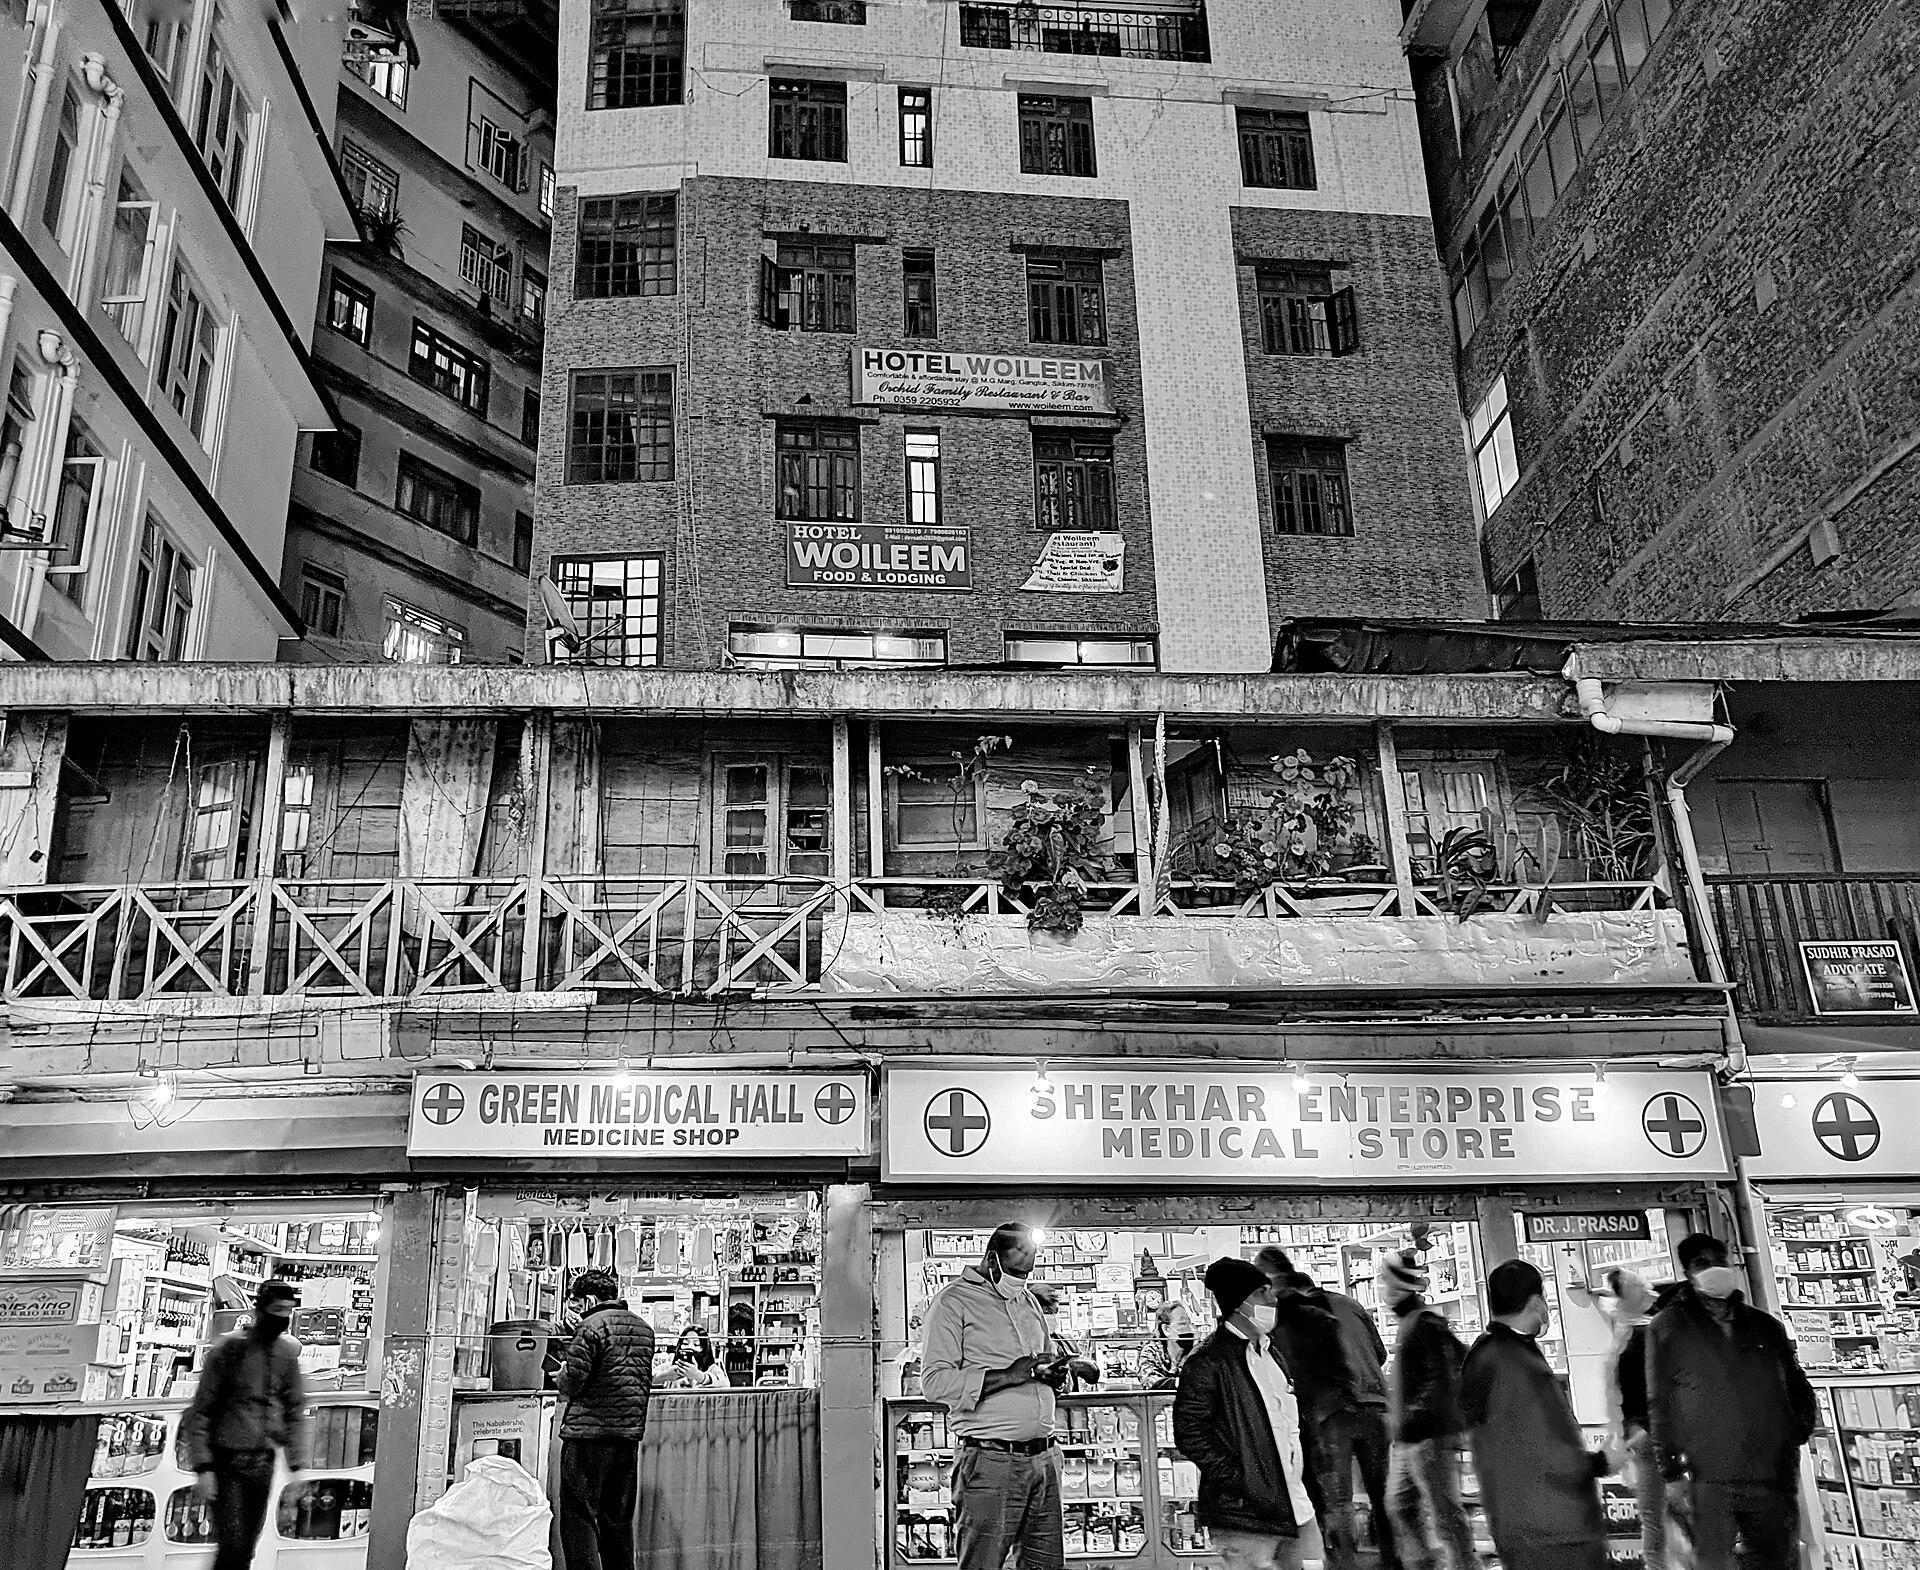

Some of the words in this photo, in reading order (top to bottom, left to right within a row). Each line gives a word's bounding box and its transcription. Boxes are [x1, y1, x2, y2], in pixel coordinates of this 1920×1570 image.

[864, 351, 961, 374] HOTEL
[967, 357, 1101, 380] WOILEEM
[867, 371, 909, 380] Comfortable
[879, 381, 920, 394] Orchid
[923, 383, 973, 401] Family
[975, 386, 1047, 400] Restaurant
[1050, 389, 1061, 400] &
[1062, 389, 1092, 401] Bar
[893, 395, 917, 405] 0359
[920, 396, 961, 407] 2205932
[1009, 402, 1093, 411] www.woileem.com
[793, 525, 862, 540] HOTEL
[793, 541, 966, 572] WOILEEM
[813, 570, 856, 582] FOOD
[861, 572, 872, 583] &
[877, 572, 946, 584] LODGING
[1806, 947, 1850, 959] SUDHIR
[1851, 946, 1895, 959] PRASAD
[1823, 963, 1887, 975] ADVOCATE
[479, 1084, 580, 1124] GREEN
[590, 1084, 719, 1124] MEDICAL
[730, 1084, 804, 1123] HALL
[1030, 1085, 1267, 1121] SHEKHAR
[1299, 1086, 1596, 1123] ENTERPRISE
[543, 1128, 665, 1146] MEDICINE
[673, 1128, 740, 1146] SHOP
[1102, 1127, 1319, 1158] MEDICAL
[1358, 1127, 1516, 1159] STORE
[1533, 1217, 1560, 1234] DR.
[1562, 1216, 1575, 1233] J.
[1577, 1215, 1639, 1232] PRASAD
[473, 1428, 502, 1436] celebrate
